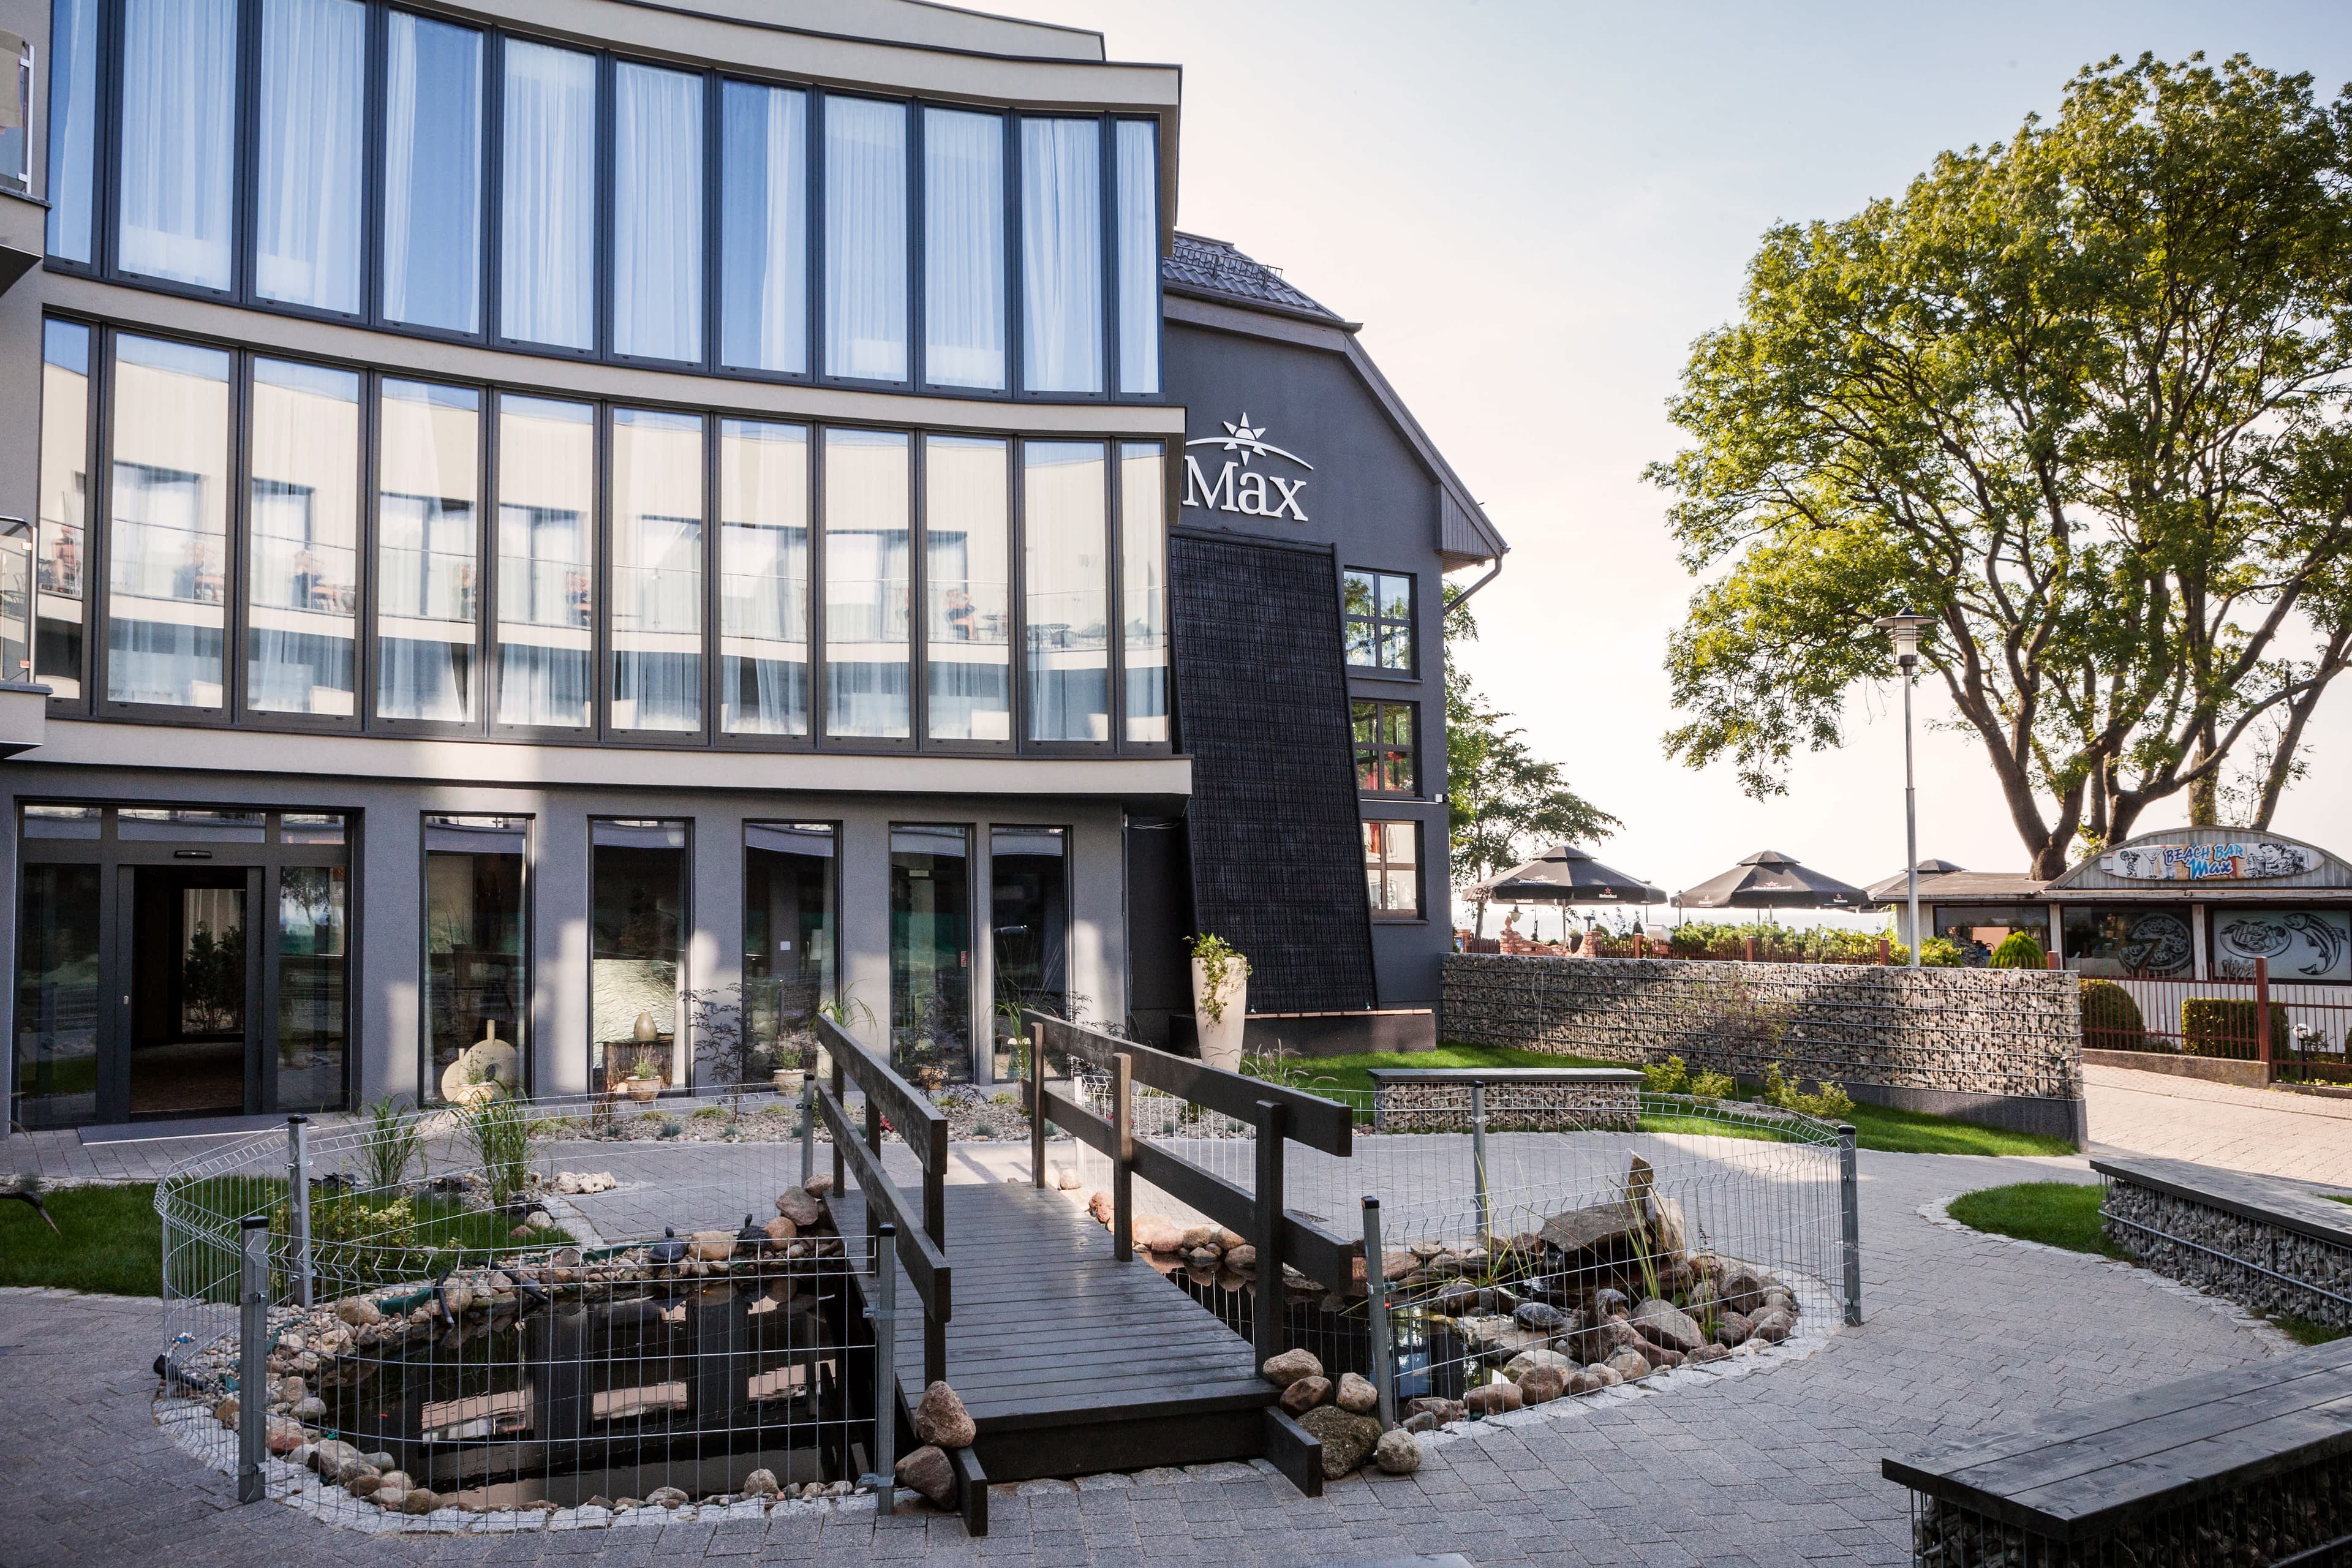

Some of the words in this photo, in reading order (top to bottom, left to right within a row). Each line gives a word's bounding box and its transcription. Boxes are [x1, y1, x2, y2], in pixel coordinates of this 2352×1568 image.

[1182, 455, 1309, 521] Max
[2164, 845, 2211, 864] BEACH
[2214, 843, 2244, 860] BAR
[2187, 858, 2233, 880] Max
